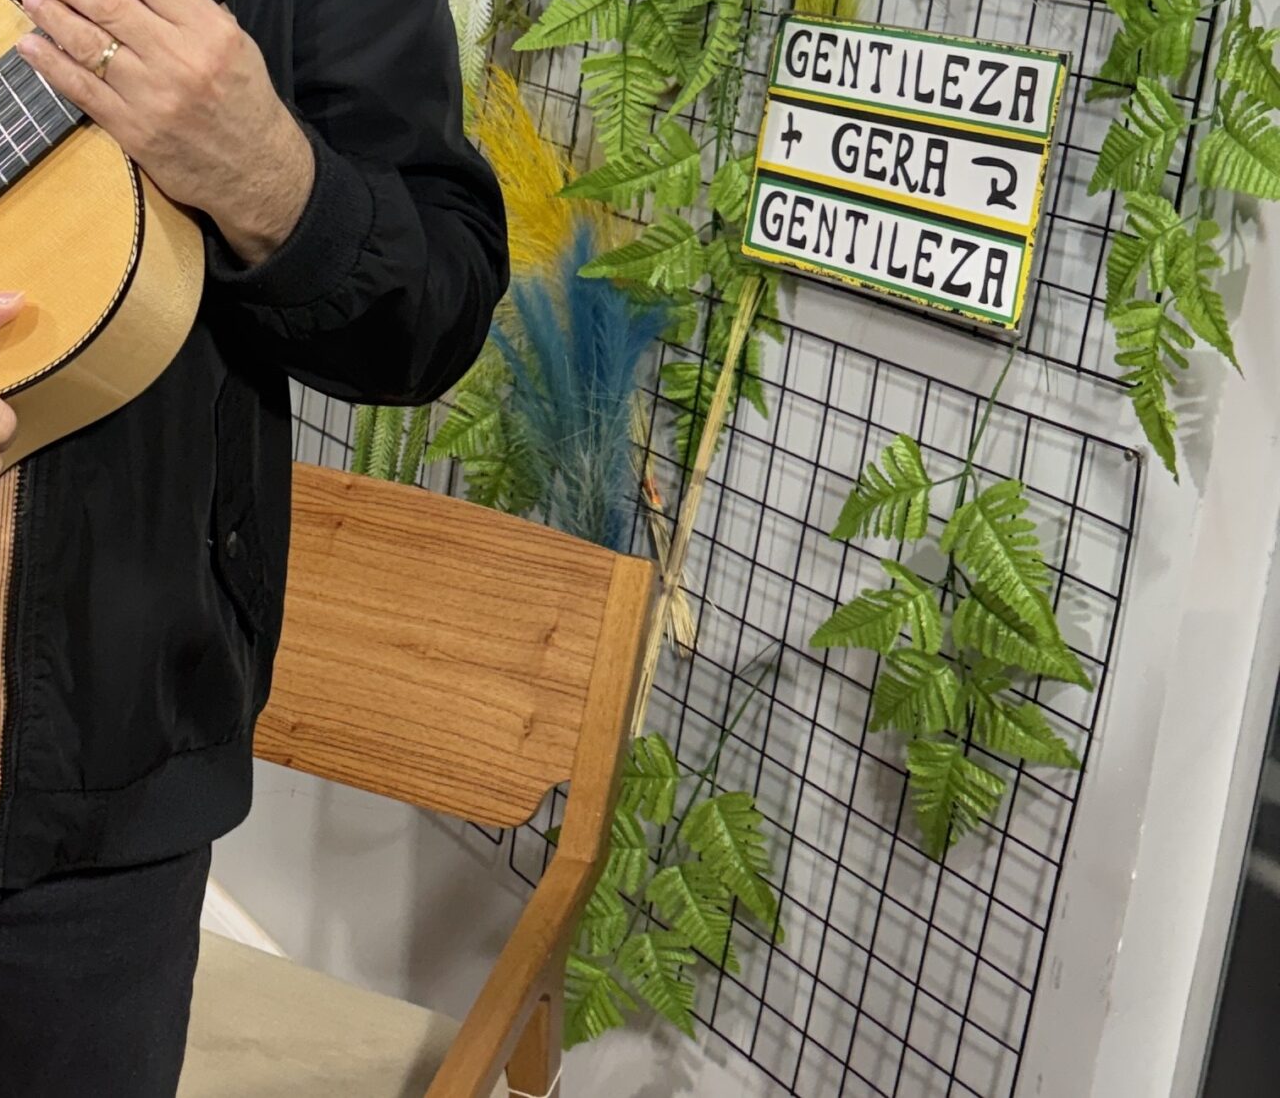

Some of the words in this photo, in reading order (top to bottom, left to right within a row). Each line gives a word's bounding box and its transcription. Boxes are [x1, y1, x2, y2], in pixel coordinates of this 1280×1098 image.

[784, 29, 1039, 123] GENTILEZA
[831, 122, 949, 197] GERA
[759, 190, 1009, 308] GENTILEZA
